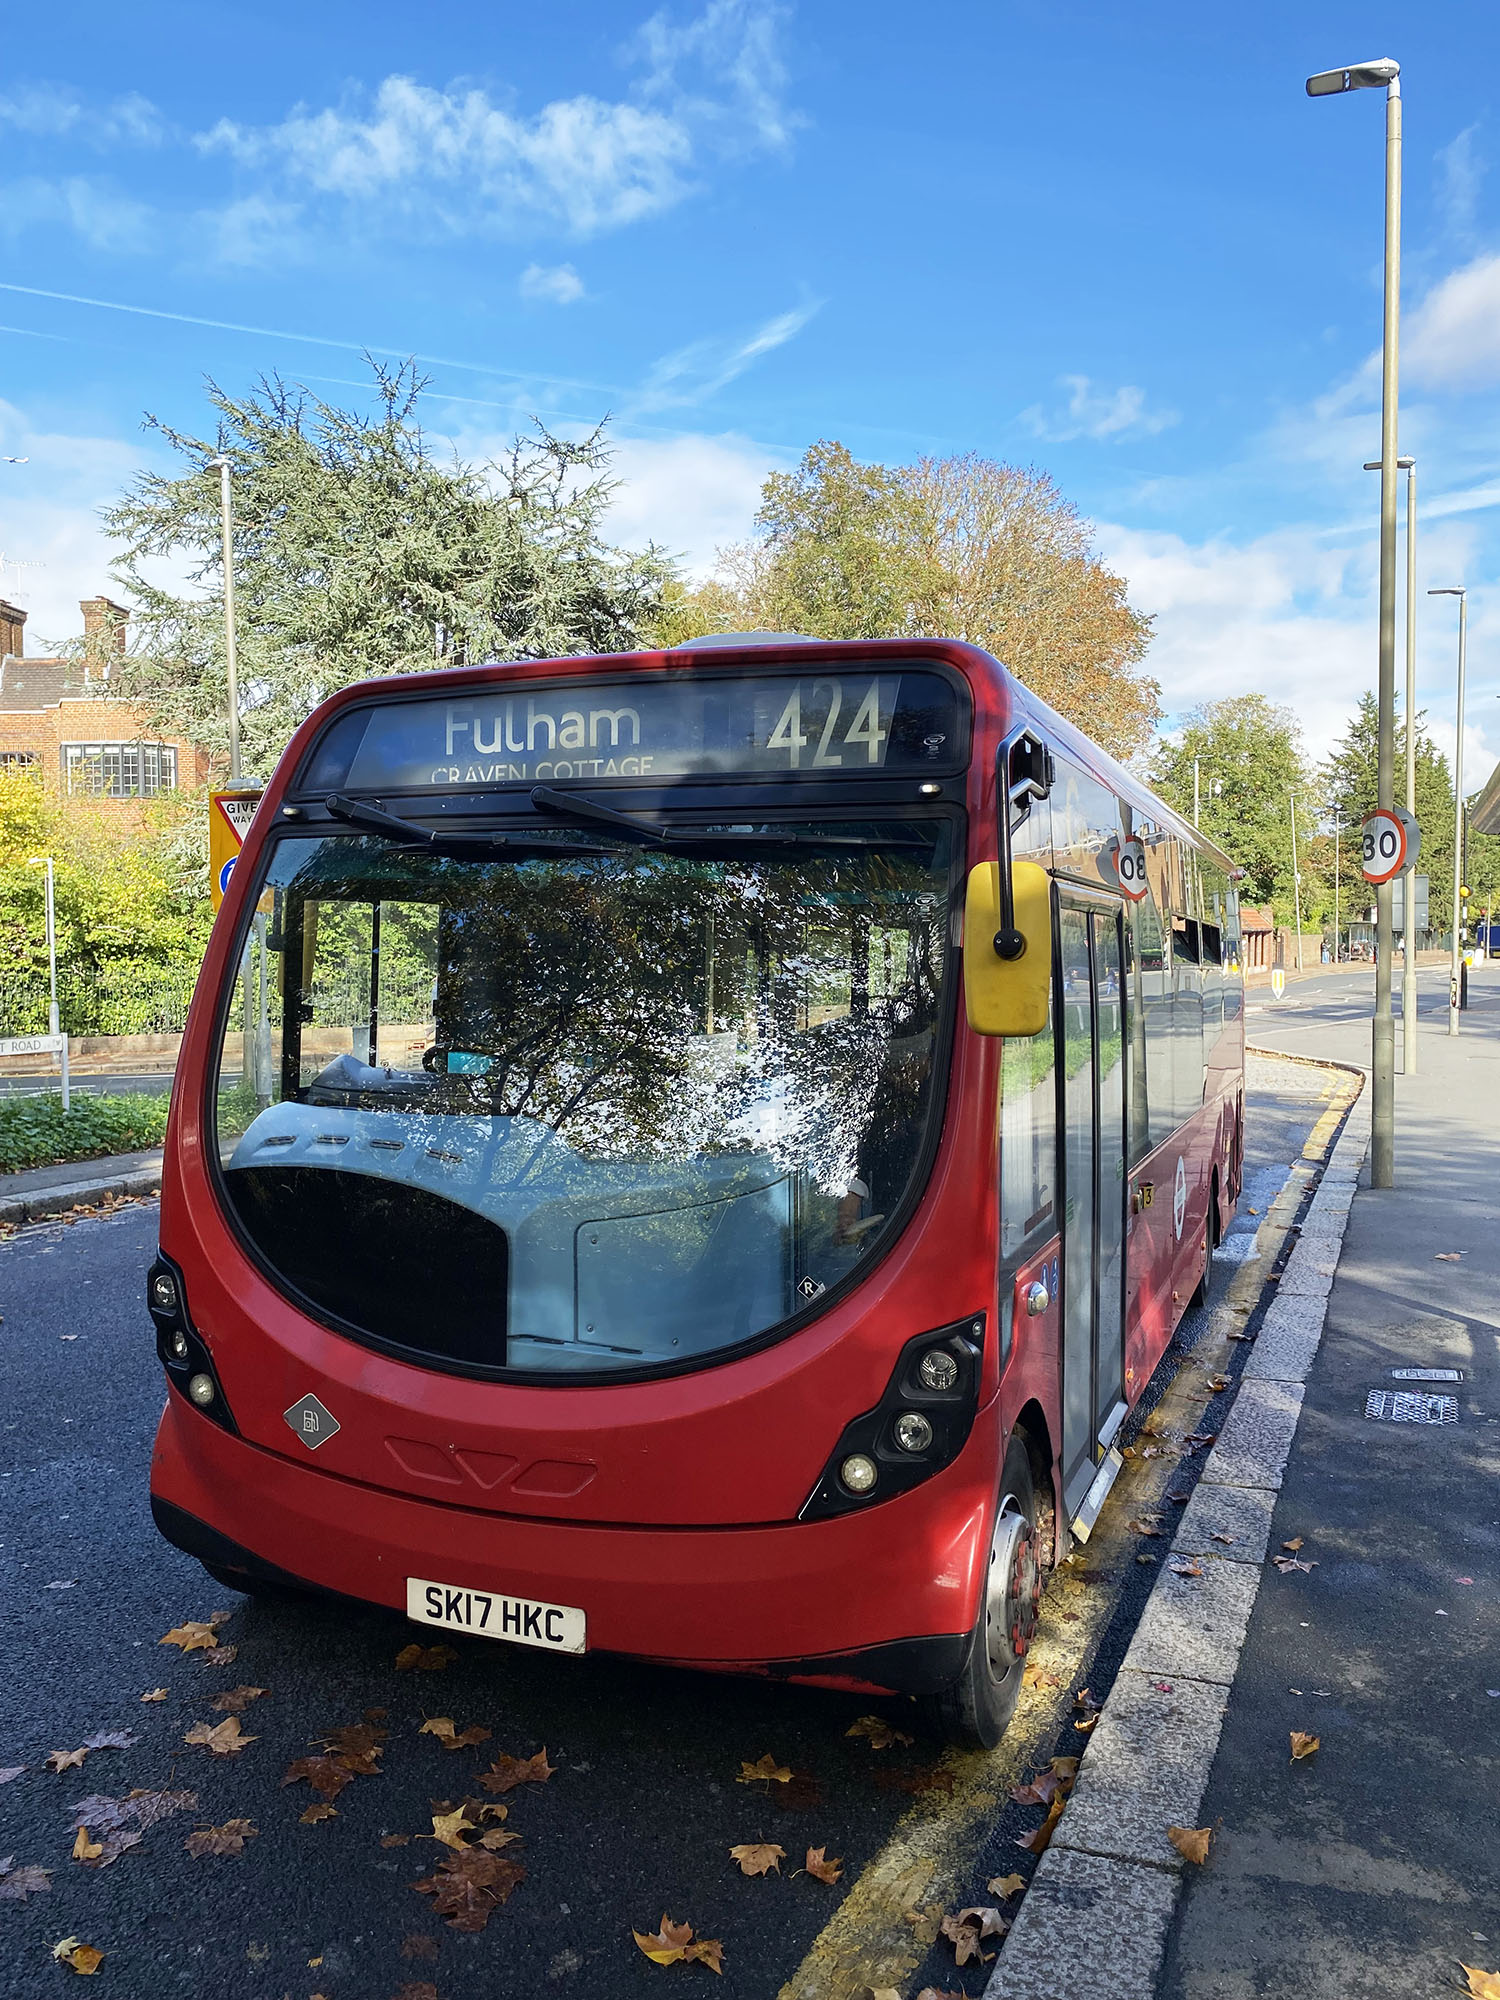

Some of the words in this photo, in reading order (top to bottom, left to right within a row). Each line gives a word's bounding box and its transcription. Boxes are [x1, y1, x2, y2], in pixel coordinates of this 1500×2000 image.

[446, 700, 640, 755] Fulham
[767, 676, 886, 768] 424
[431, 763, 527, 783] CRAVEN
[535, 756, 654, 780] COTTAGE
[227, 802, 257, 813] GIVE
[1363, 830, 1397, 861] 30
[11, 1040, 41, 1051] ROAD
[804, 1281, 814, 1294] R
[425, 1586, 492, 1628] SK17
[502, 1600, 564, 1643] HKC
